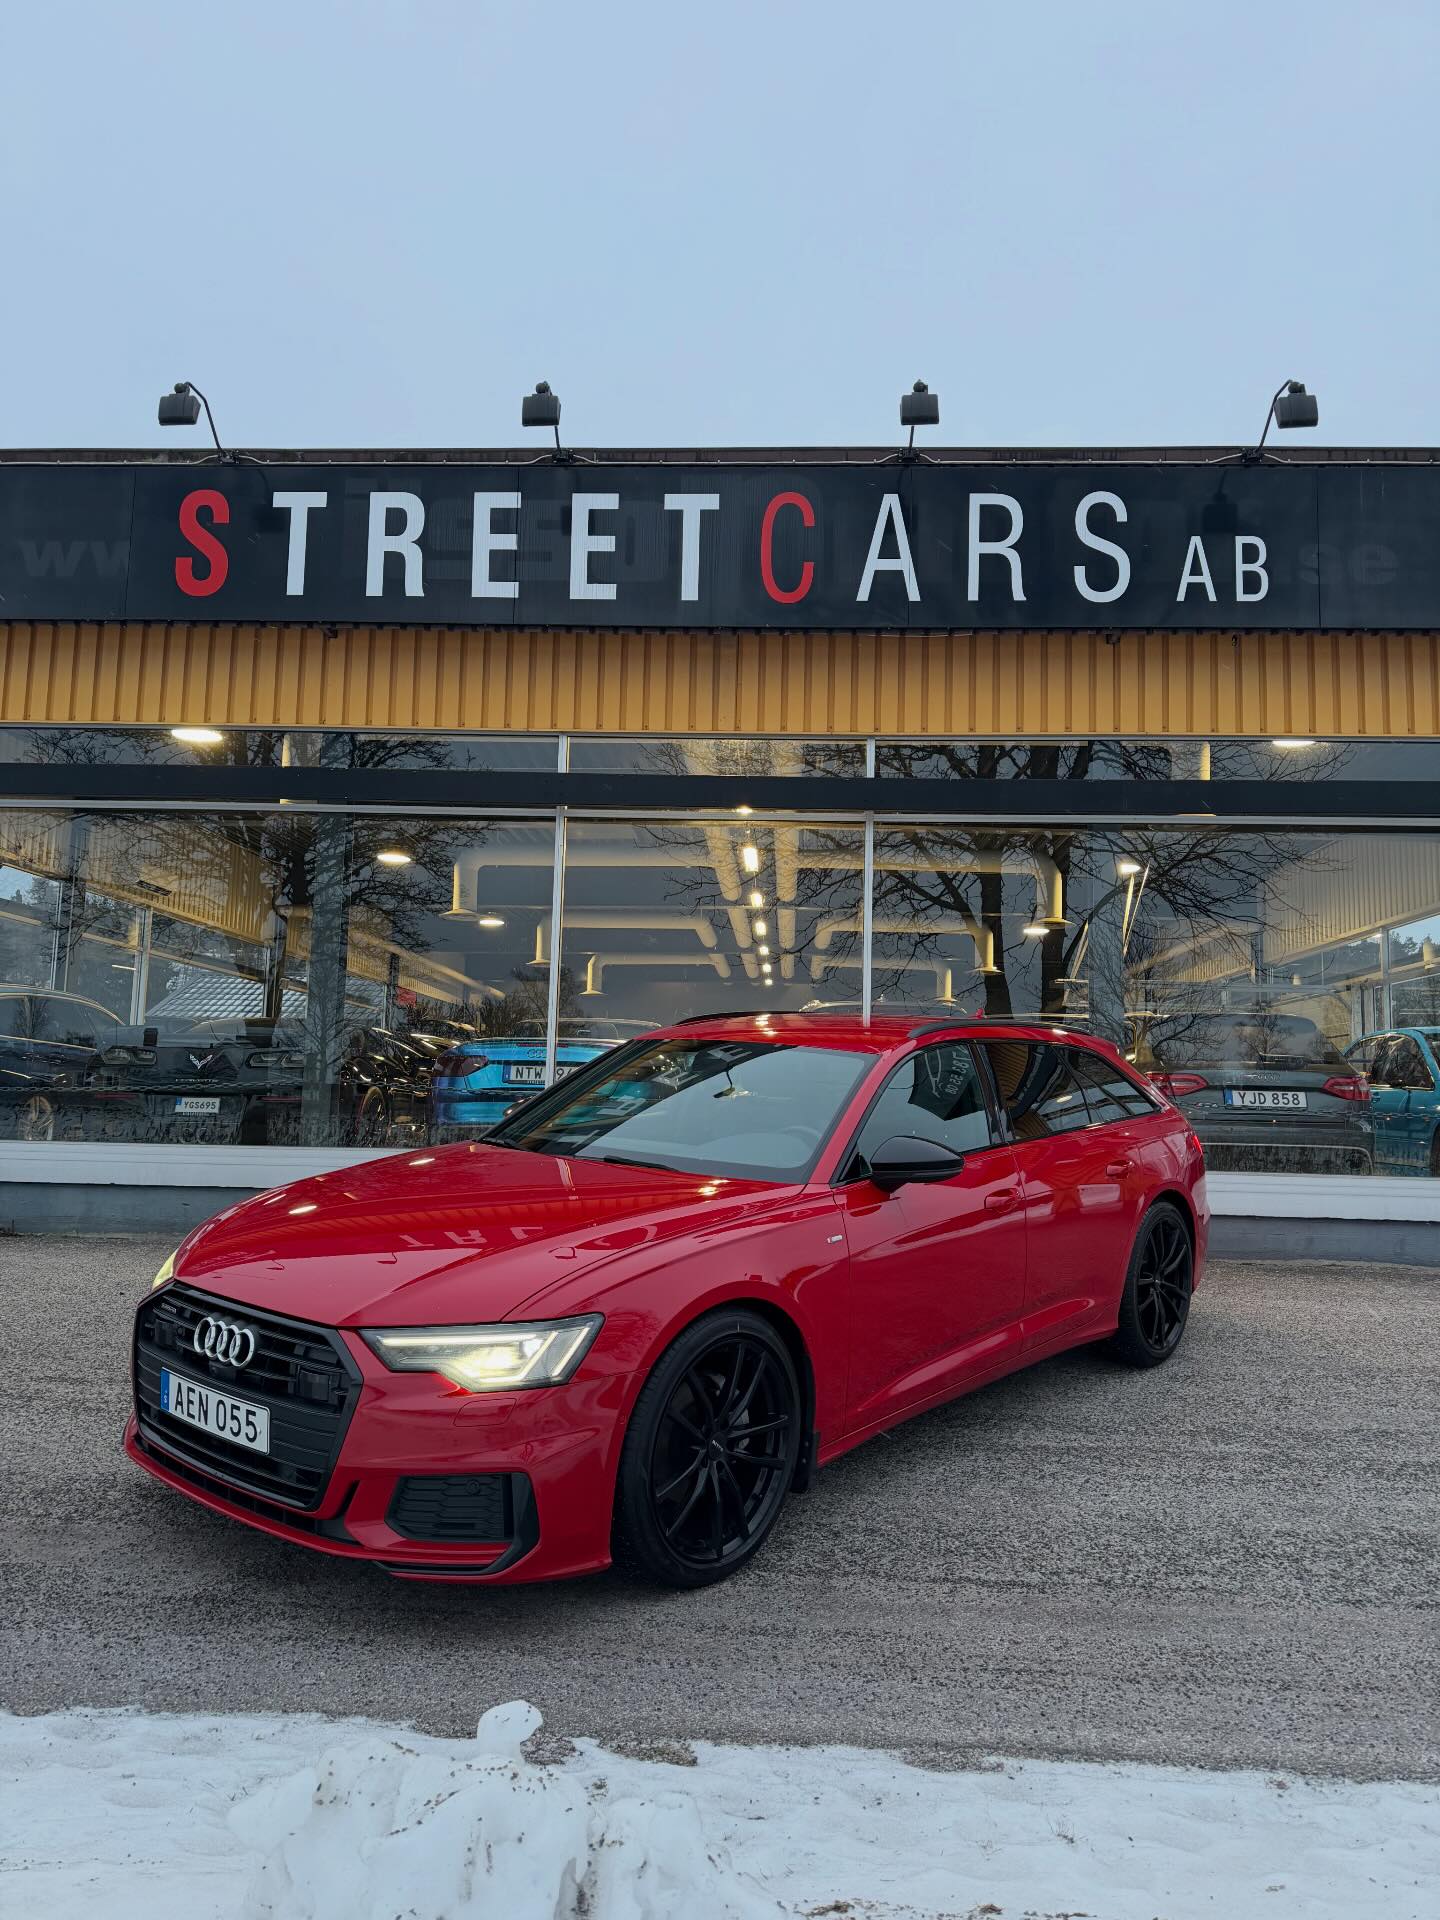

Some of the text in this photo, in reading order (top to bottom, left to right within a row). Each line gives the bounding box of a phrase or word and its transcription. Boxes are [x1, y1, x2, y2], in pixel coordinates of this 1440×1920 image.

[1176, 535, 1269, 602] AB
[515, 1067, 543, 1079] NTW
[1238, 1092, 1301, 1106] YJD 858
[174, 1381, 258, 1443] AEN 055
